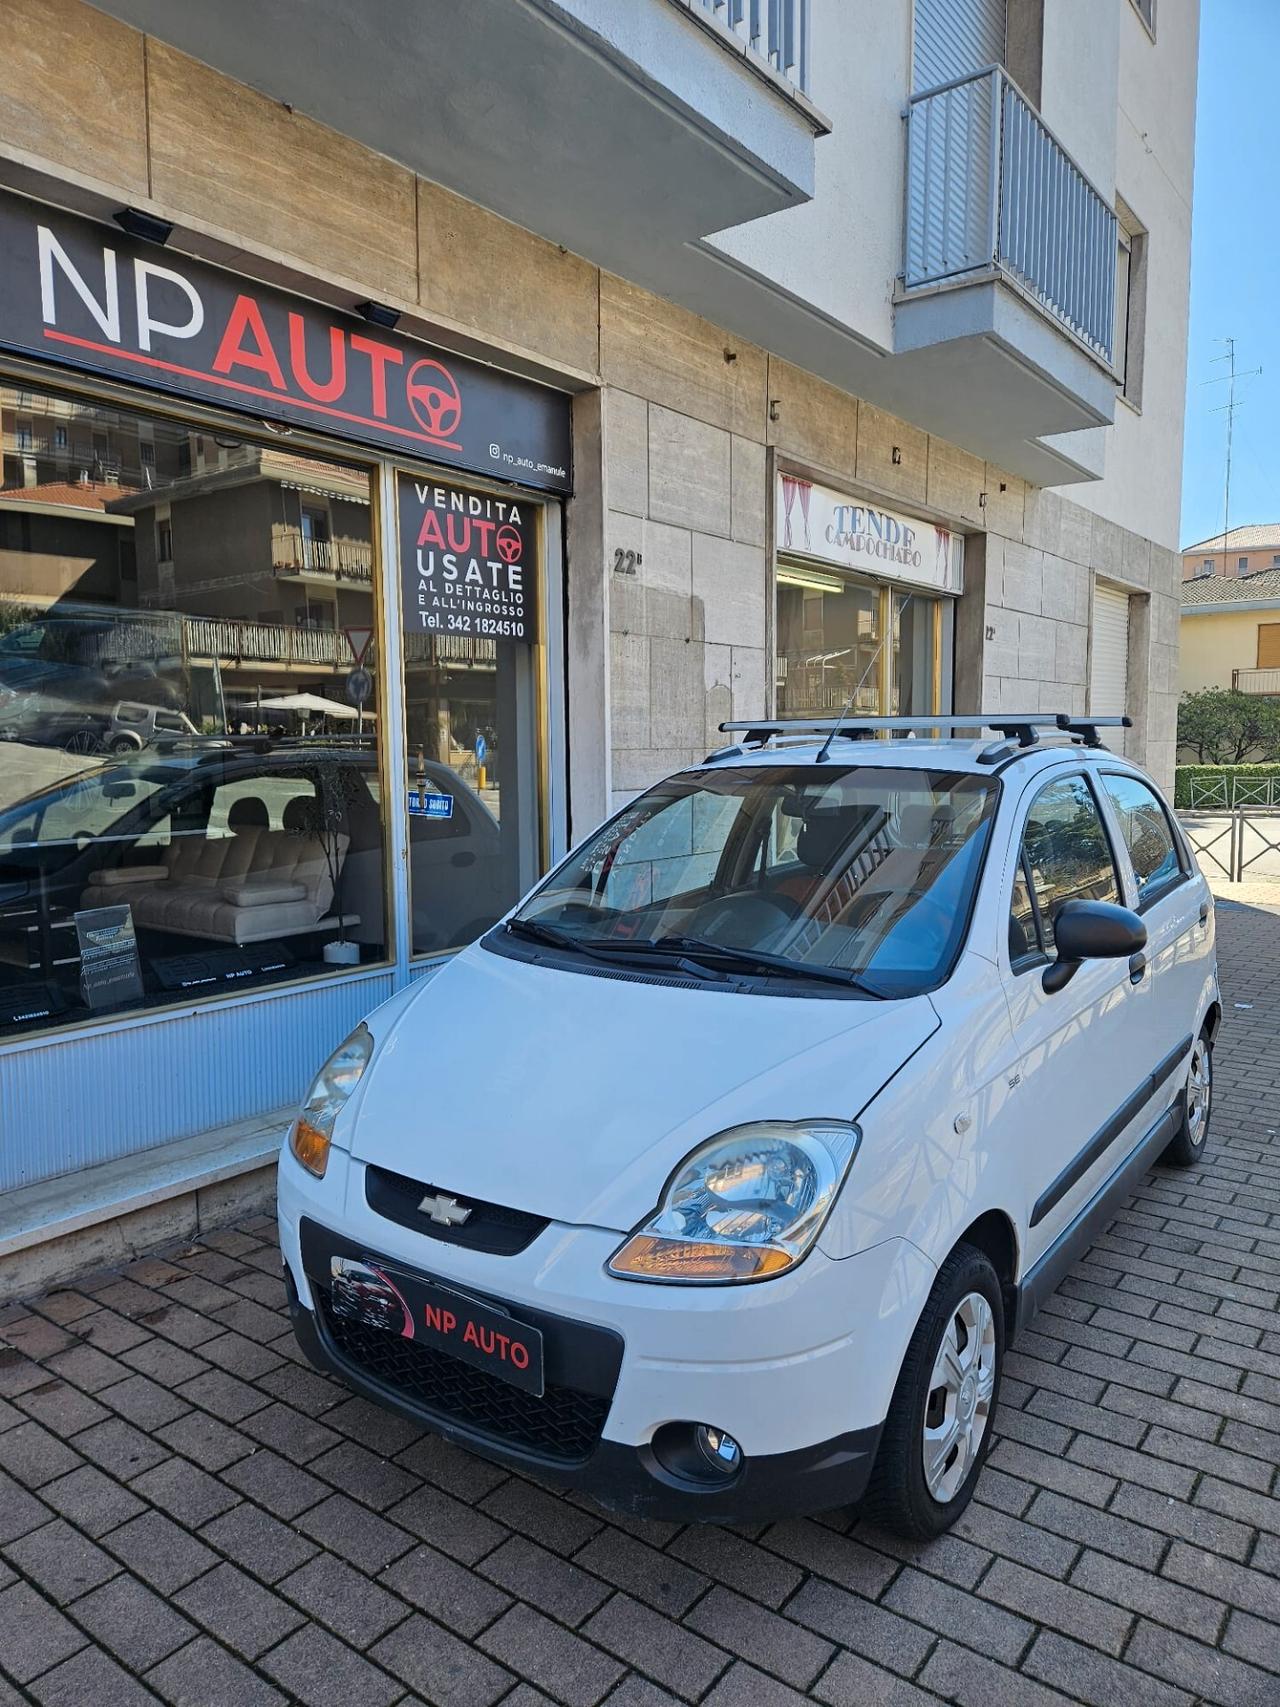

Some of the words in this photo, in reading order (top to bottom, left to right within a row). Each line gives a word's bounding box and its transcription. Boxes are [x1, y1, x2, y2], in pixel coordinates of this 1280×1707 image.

[37, 225, 204, 352] NP
[414, 482, 522, 525] VENDITA
[417, 508, 522, 563] AUTO
[416, 549, 523, 590] USATE
[418, 579, 437, 592] AL
[445, 582, 524, 604] DETTAGLIO
[418, 594, 426, 605] E
[432, 596, 524, 617] ALL'INGROSSO
[419, 610, 443, 629] Tel.
[447, 614, 471, 632] 342
[474, 617, 524, 638] 1824510
[425, 1303, 457, 1335] NP
[463, 1320, 529, 1369] AUTO
